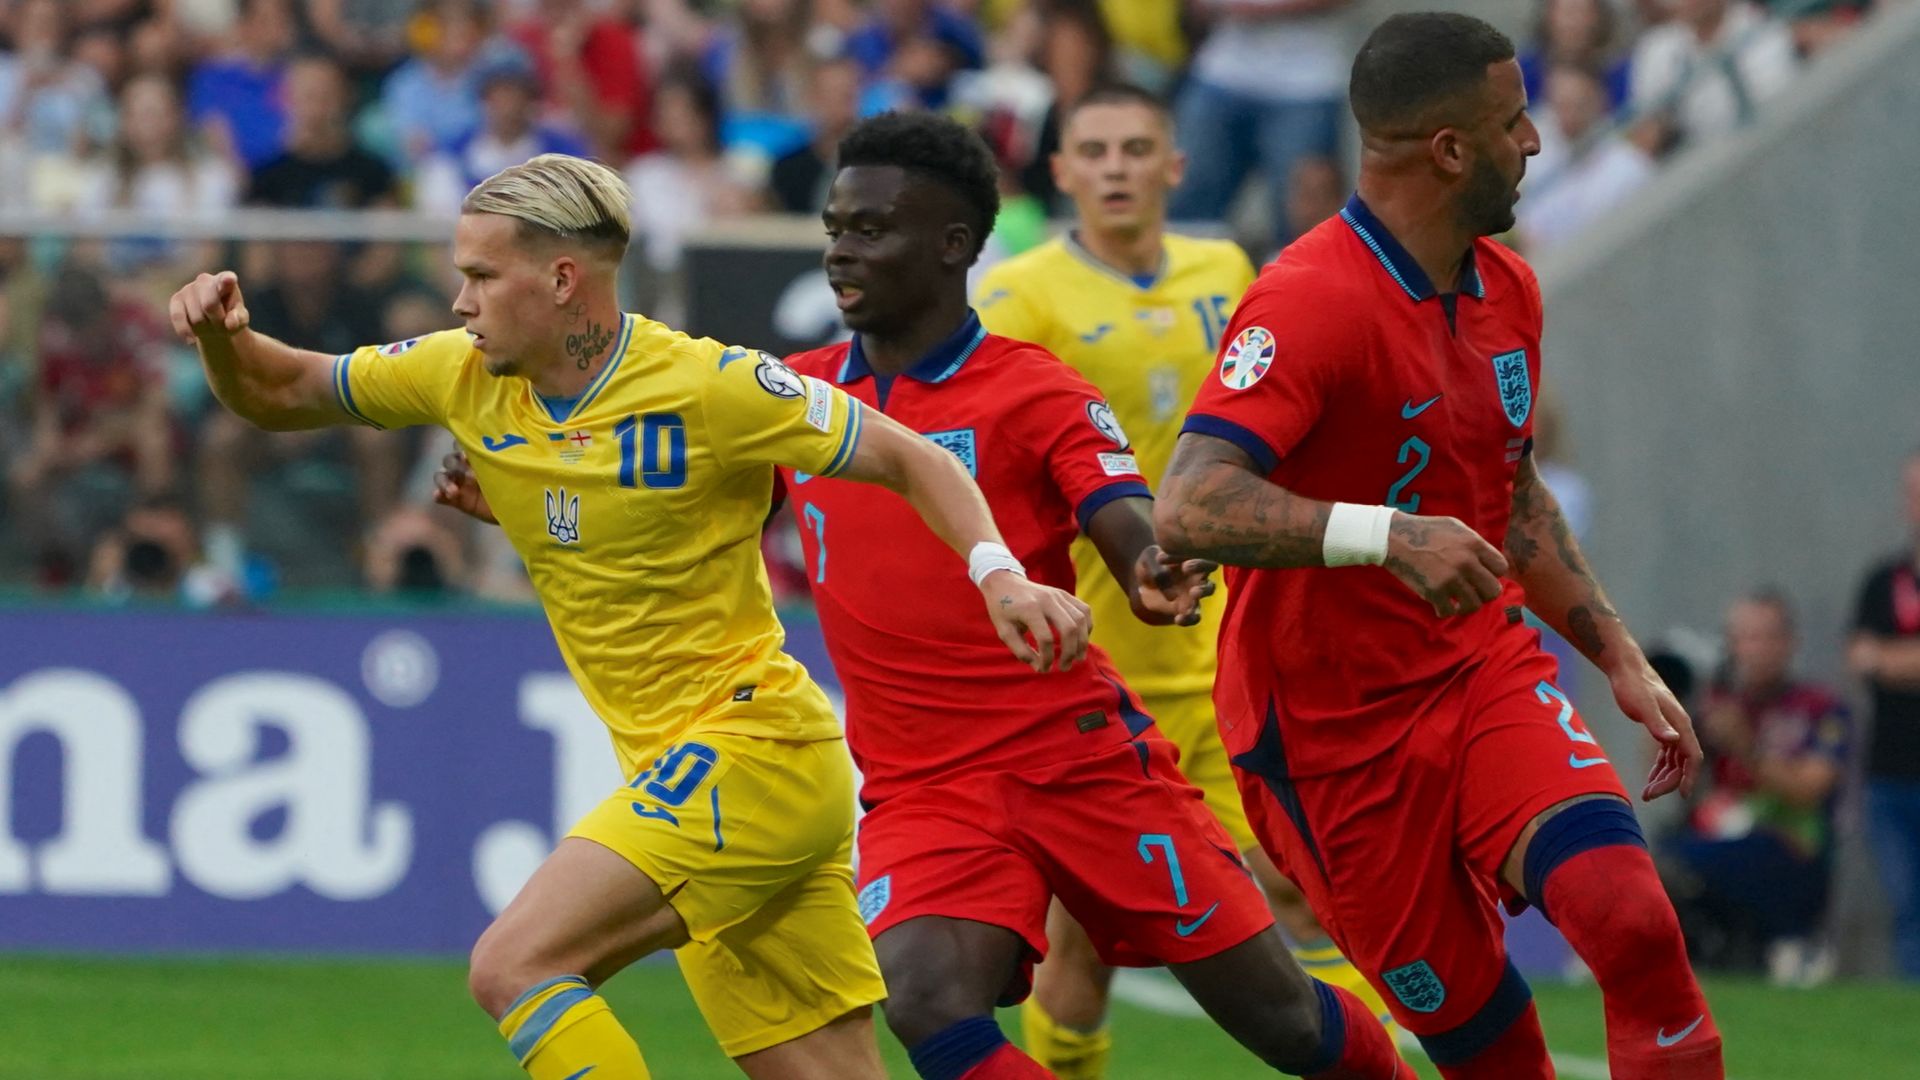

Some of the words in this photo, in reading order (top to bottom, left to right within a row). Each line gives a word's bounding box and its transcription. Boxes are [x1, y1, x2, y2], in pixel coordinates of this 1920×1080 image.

[612, 411, 689, 489] 10
[1386, 435, 1431, 513] 2
[803, 501, 827, 583] 7
[1535, 680, 1597, 746] 2
[1137, 833, 1189, 908] 7
